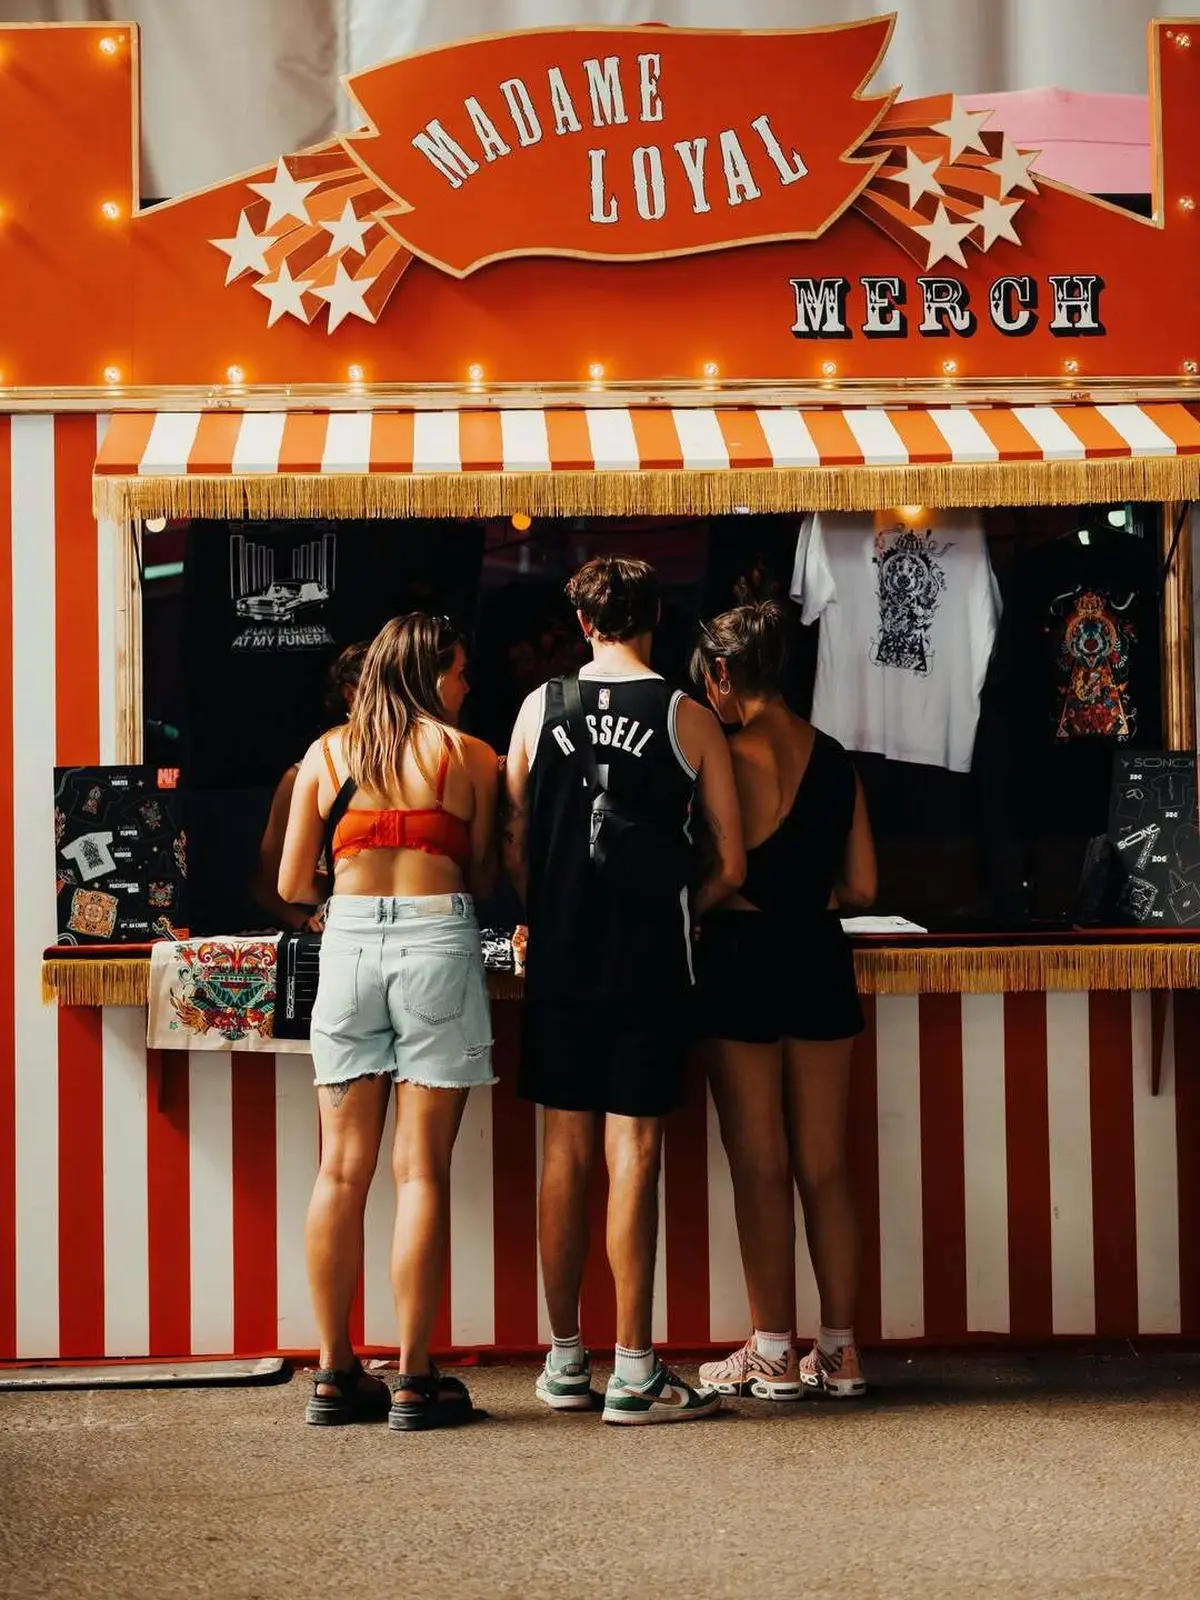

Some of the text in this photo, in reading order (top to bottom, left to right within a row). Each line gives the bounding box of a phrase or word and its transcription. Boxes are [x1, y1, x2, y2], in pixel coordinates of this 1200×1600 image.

[411, 52, 664, 190] MADAME
[588, 114, 809, 224] LOYAL
[789, 274, 1107, 339] MERCH
[232, 636, 251, 647] AT
[253, 635, 276, 646] MY
[552, 714, 654, 757] RSSELL
